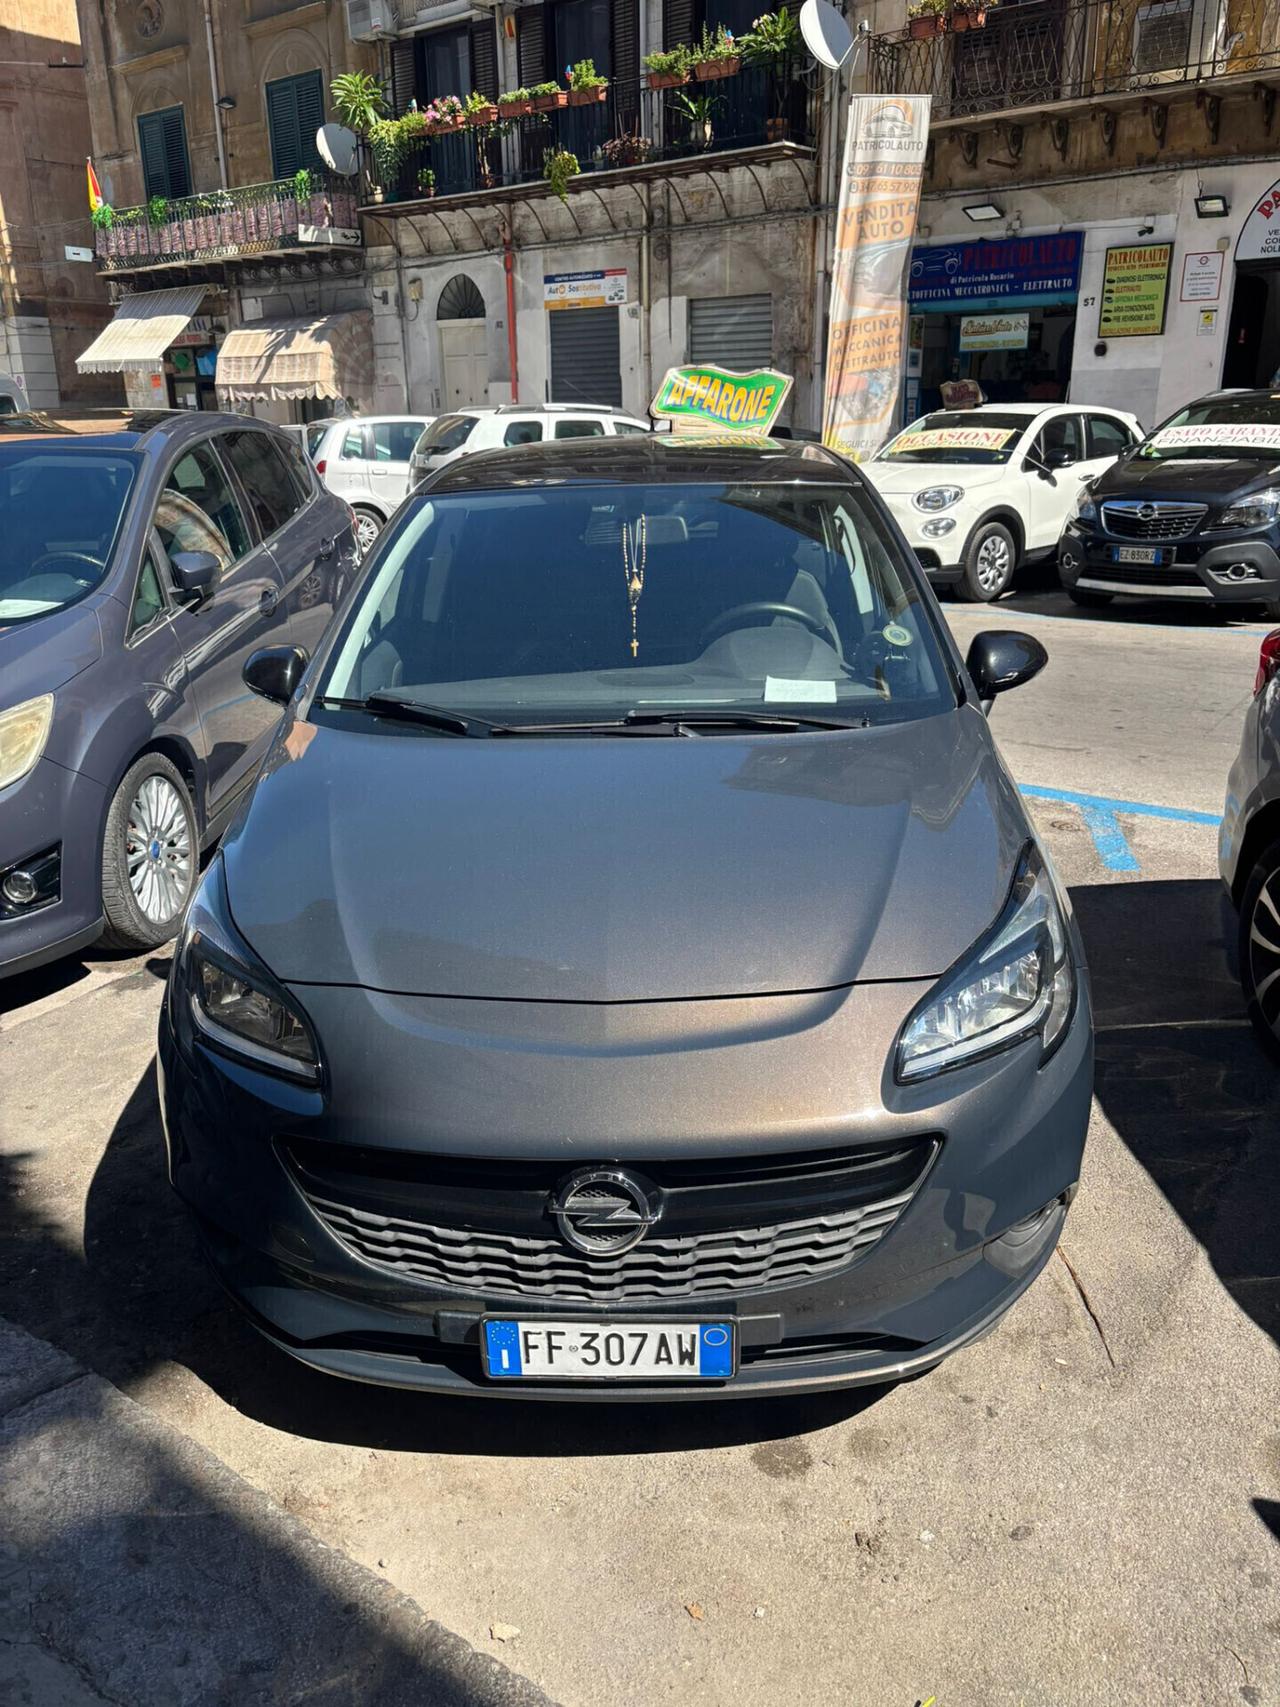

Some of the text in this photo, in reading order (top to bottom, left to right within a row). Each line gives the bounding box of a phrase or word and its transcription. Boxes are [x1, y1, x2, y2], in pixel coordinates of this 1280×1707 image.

[852, 140, 923, 152] PATRICOLAUTO
[890, 164, 902, 176] 10
[843, 201, 917, 227] VENDITA
[859, 219, 904, 241] AUTO
[963, 238, 1077, 272] PATRICOLAUTO
[1107, 248, 1169, 266] PATRICOLAUTO
[954, 282, 1010, 298] MECCATRONICA
[1022, 278, 1073, 292] ELETTRAUTO
[1083, 296, 1096, 307] 57
[833, 316, 901, 341] OFFICINA
[832, 333, 904, 357] MECCANICA
[834, 350, 902, 372] ELETTRAUTO
[666, 375, 776, 423] AFFARONE
[896, 432, 1005, 448] OCCASIONE
[1164, 426, 1280, 438] USATO GARANT
[501, 1349, 509, 1369] I
[523, 1331, 697, 1367] FF 307AW
